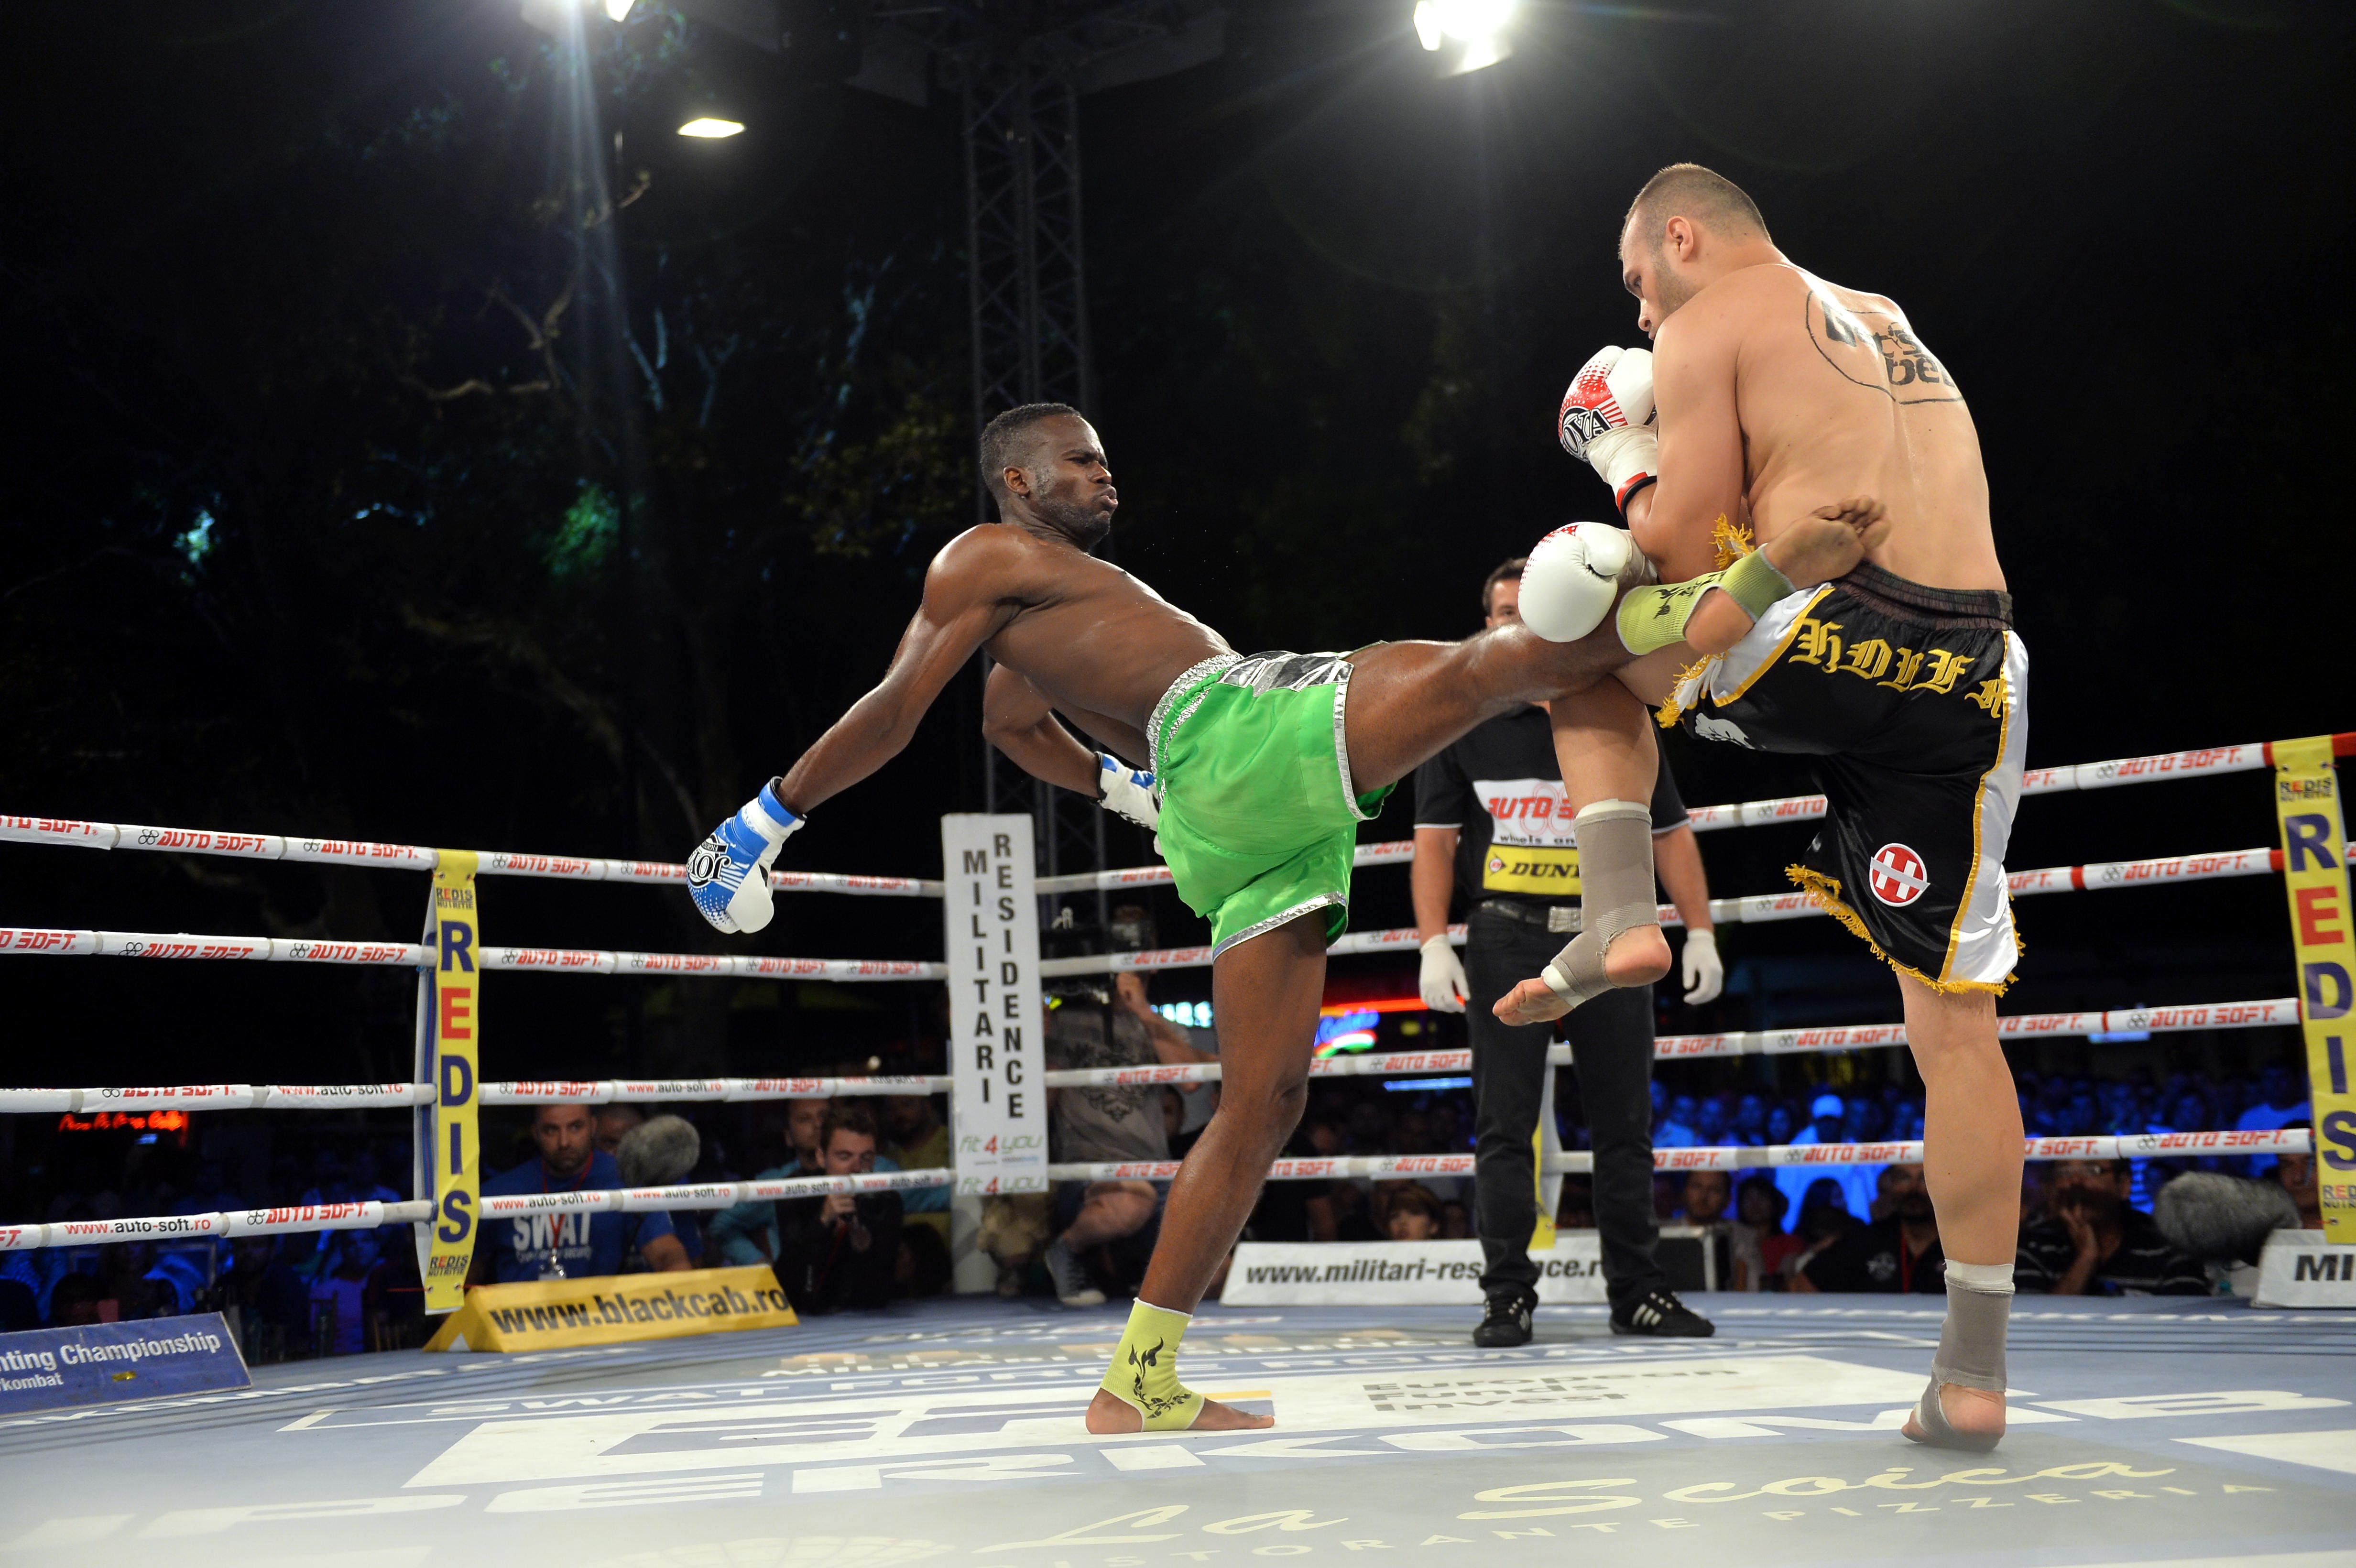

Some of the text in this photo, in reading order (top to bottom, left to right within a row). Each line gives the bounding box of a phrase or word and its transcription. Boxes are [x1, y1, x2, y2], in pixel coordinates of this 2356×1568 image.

[2118, 755, 2175, 776] AUTO
[1776, 798, 1825, 816] AUTO
[158, 831, 211, 849] AUTO
[508, 856, 548, 871] AUTO
[635, 862, 670, 877] AUTO
[2124, 861, 2180, 880] AUTO
[436, 888, 473, 902] REDIS
[308, 944, 358, 960] AUTO
[517, 950, 558, 964] AUTO
[645, 956, 681, 969] AUTO
[963, 850, 993, 1103] MILITARI
[994, 833, 1024, 1119] RESIDENCE
[2285, 814, 2356, 1170] REDIS
[2150, 1009, 2208, 1027] AUTO
[1797, 1030, 1846, 1046] AUTO
[1385, 1055, 1426, 1070] AUTO
[438, 920, 475, 1242] REDIS
[515, 1082, 555, 1095] AUTO
[983, 1134, 999, 1154] 4
[1002, 1134, 1044, 1154] you
[2160, 1132, 2219, 1148] AUTO
[1804, 1146, 1853, 1161] AUTO
[1395, 1158, 1435, 1171] AUTO
[985, 1176, 999, 1193] 4
[492, 1192, 601, 1210] www.auto-soft.ro
[266, 1206, 313, 1223] AUTO
[65, 1218, 211, 1235] www.auto-soft.ro
[430, 1255, 469, 1268] REDIS
[489, 1285, 789, 1335] www.blackcab.ro
[60, 1331, 221, 1366] Championship
[1098, 1340, 1468, 1359] SIDENCE
[1363, 1370, 1742, 1391] European
[425, 1386, 790, 1416] SWAT
[1367, 1384, 1610, 1401] Funds
[1374, 1393, 1629, 1412] Invest
[972, 1461, 2177, 1553] La Scoica
[1761, 1484, 2279, 1522] PIZZERIA
